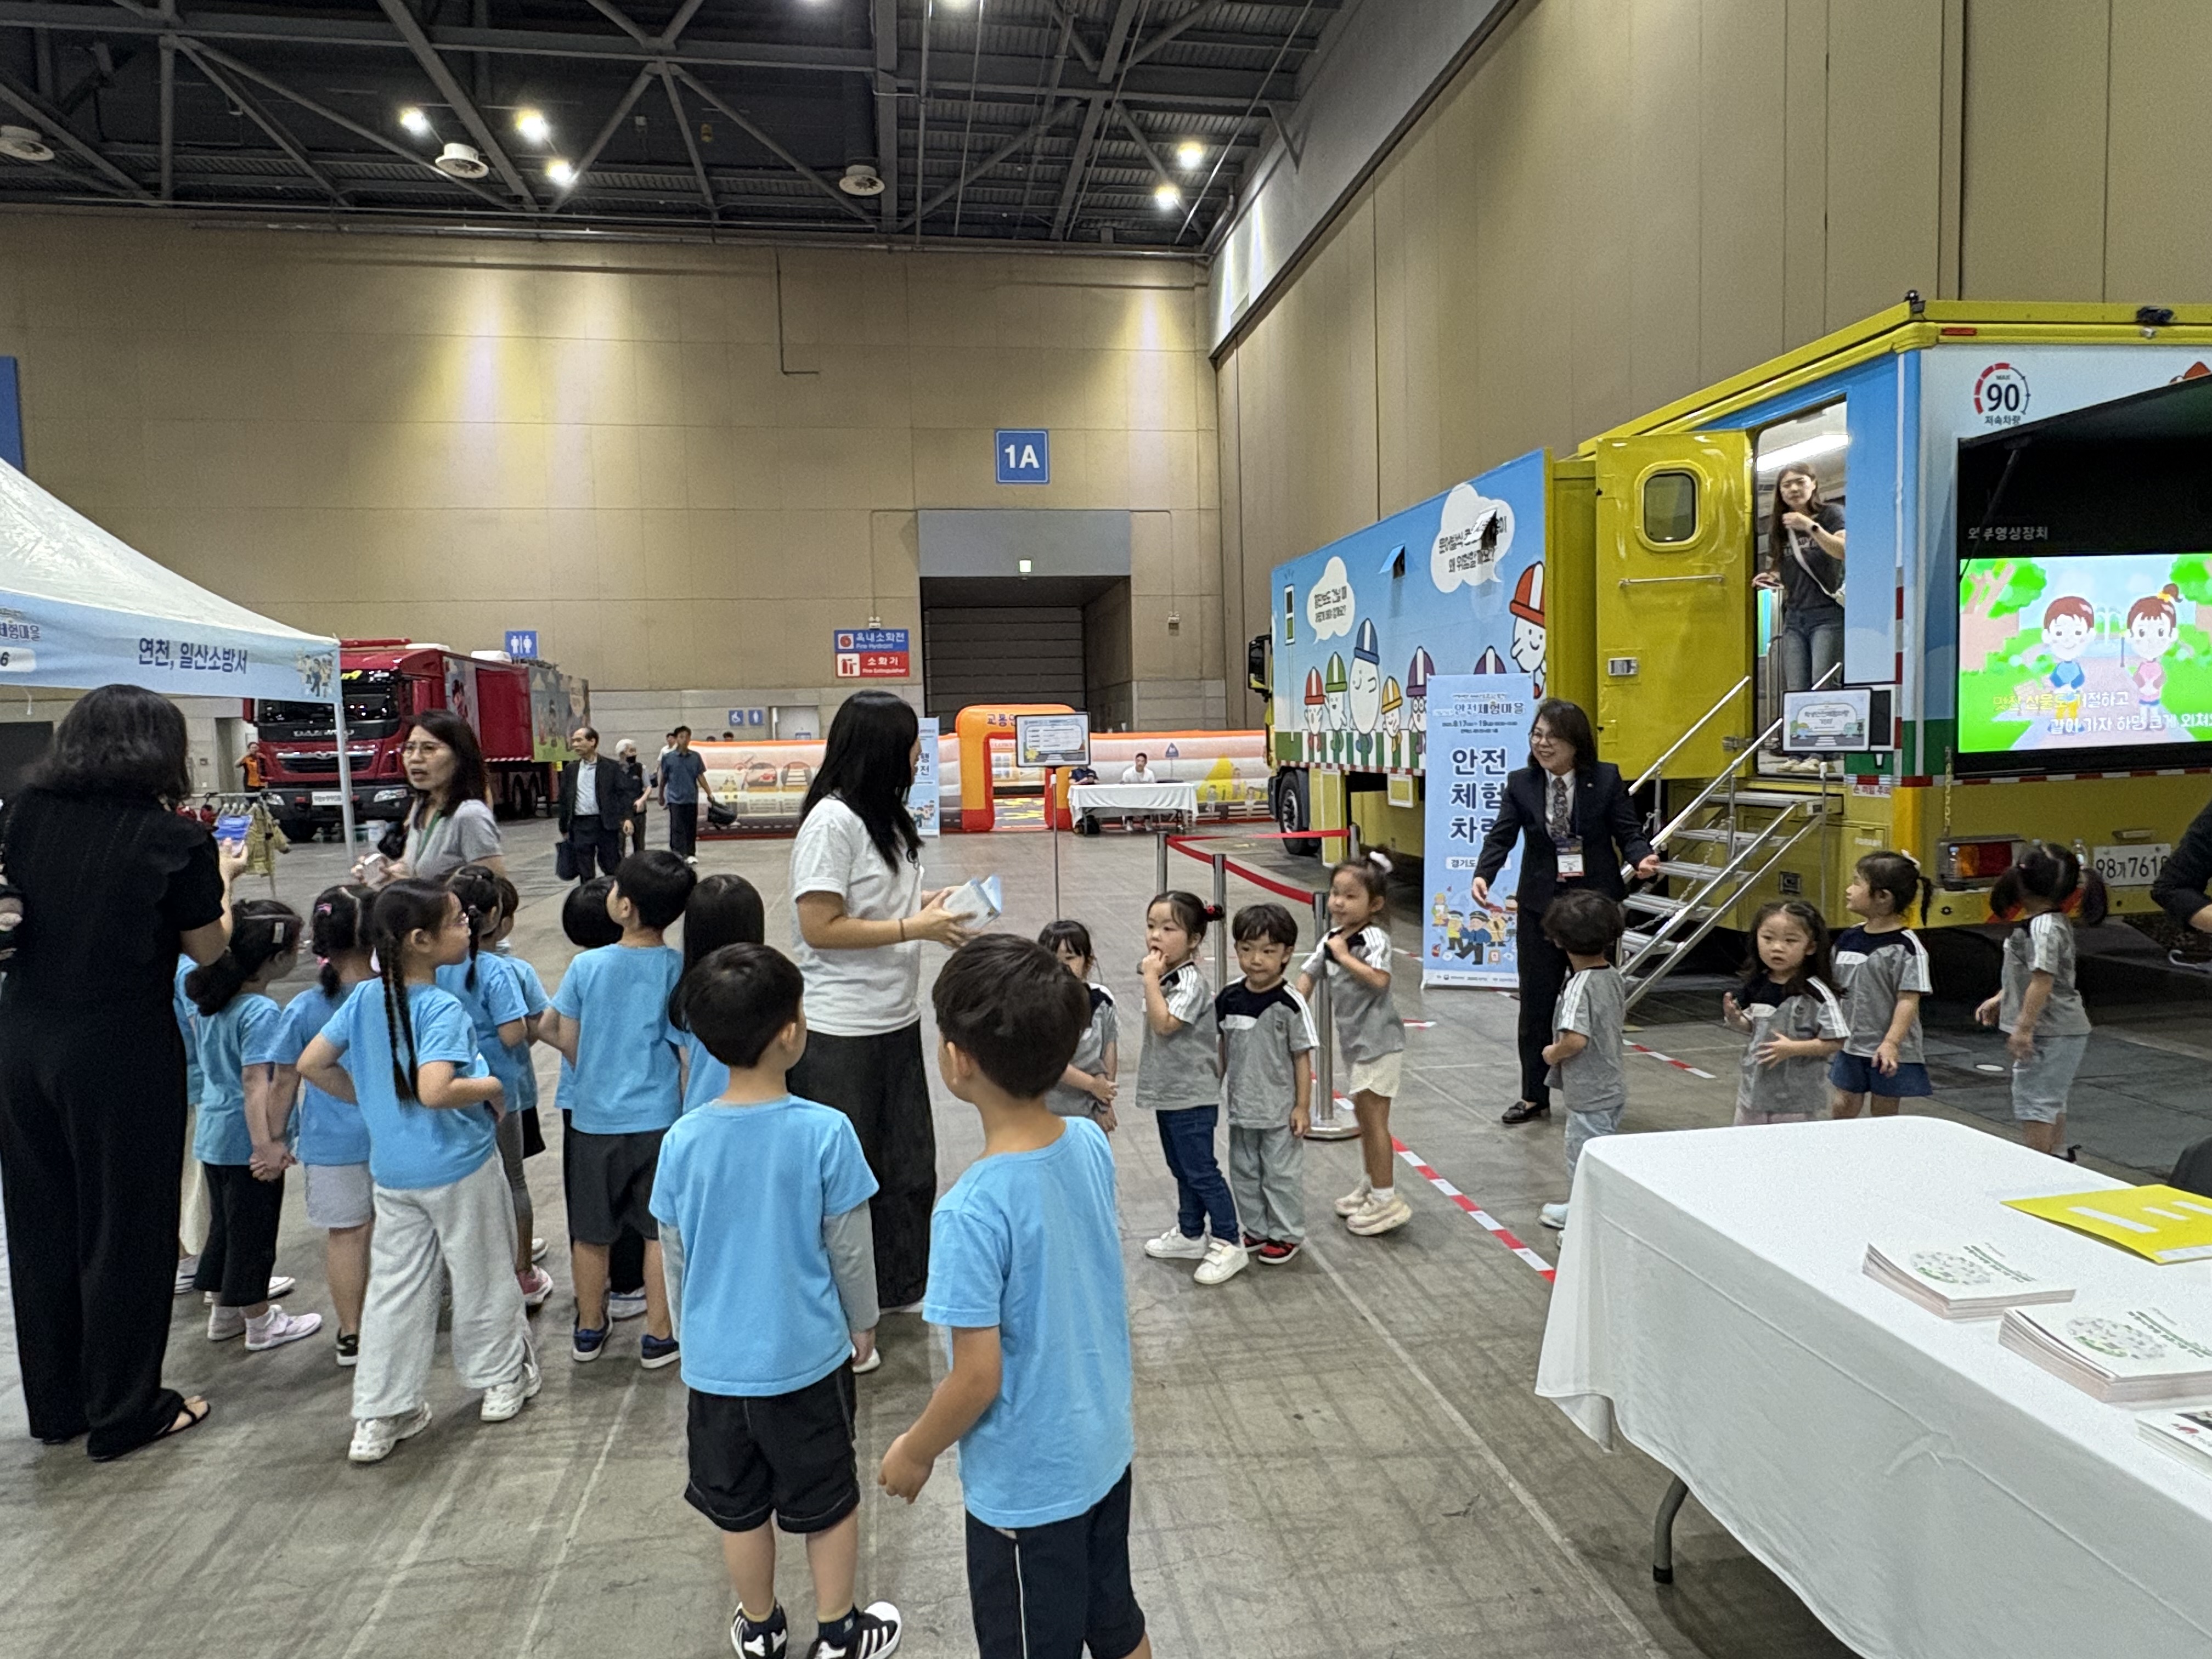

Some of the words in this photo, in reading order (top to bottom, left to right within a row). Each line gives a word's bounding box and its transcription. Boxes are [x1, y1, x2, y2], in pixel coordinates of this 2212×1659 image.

[1987, 383, 2020, 411] 90
[1984, 415, 2021, 426] 저속차량
[1005, 444, 1040, 469] 1A
[139, 638, 174, 670] 연천,
[180, 642, 247, 675] 일산소방서
[867, 656, 899, 666] 소화기
[2084, 716, 2112, 732] 가자
[2180, 712, 2212, 729] 외쳐
[1452, 748, 1505, 775] 안전
[1451, 782, 1505, 809] 체험
